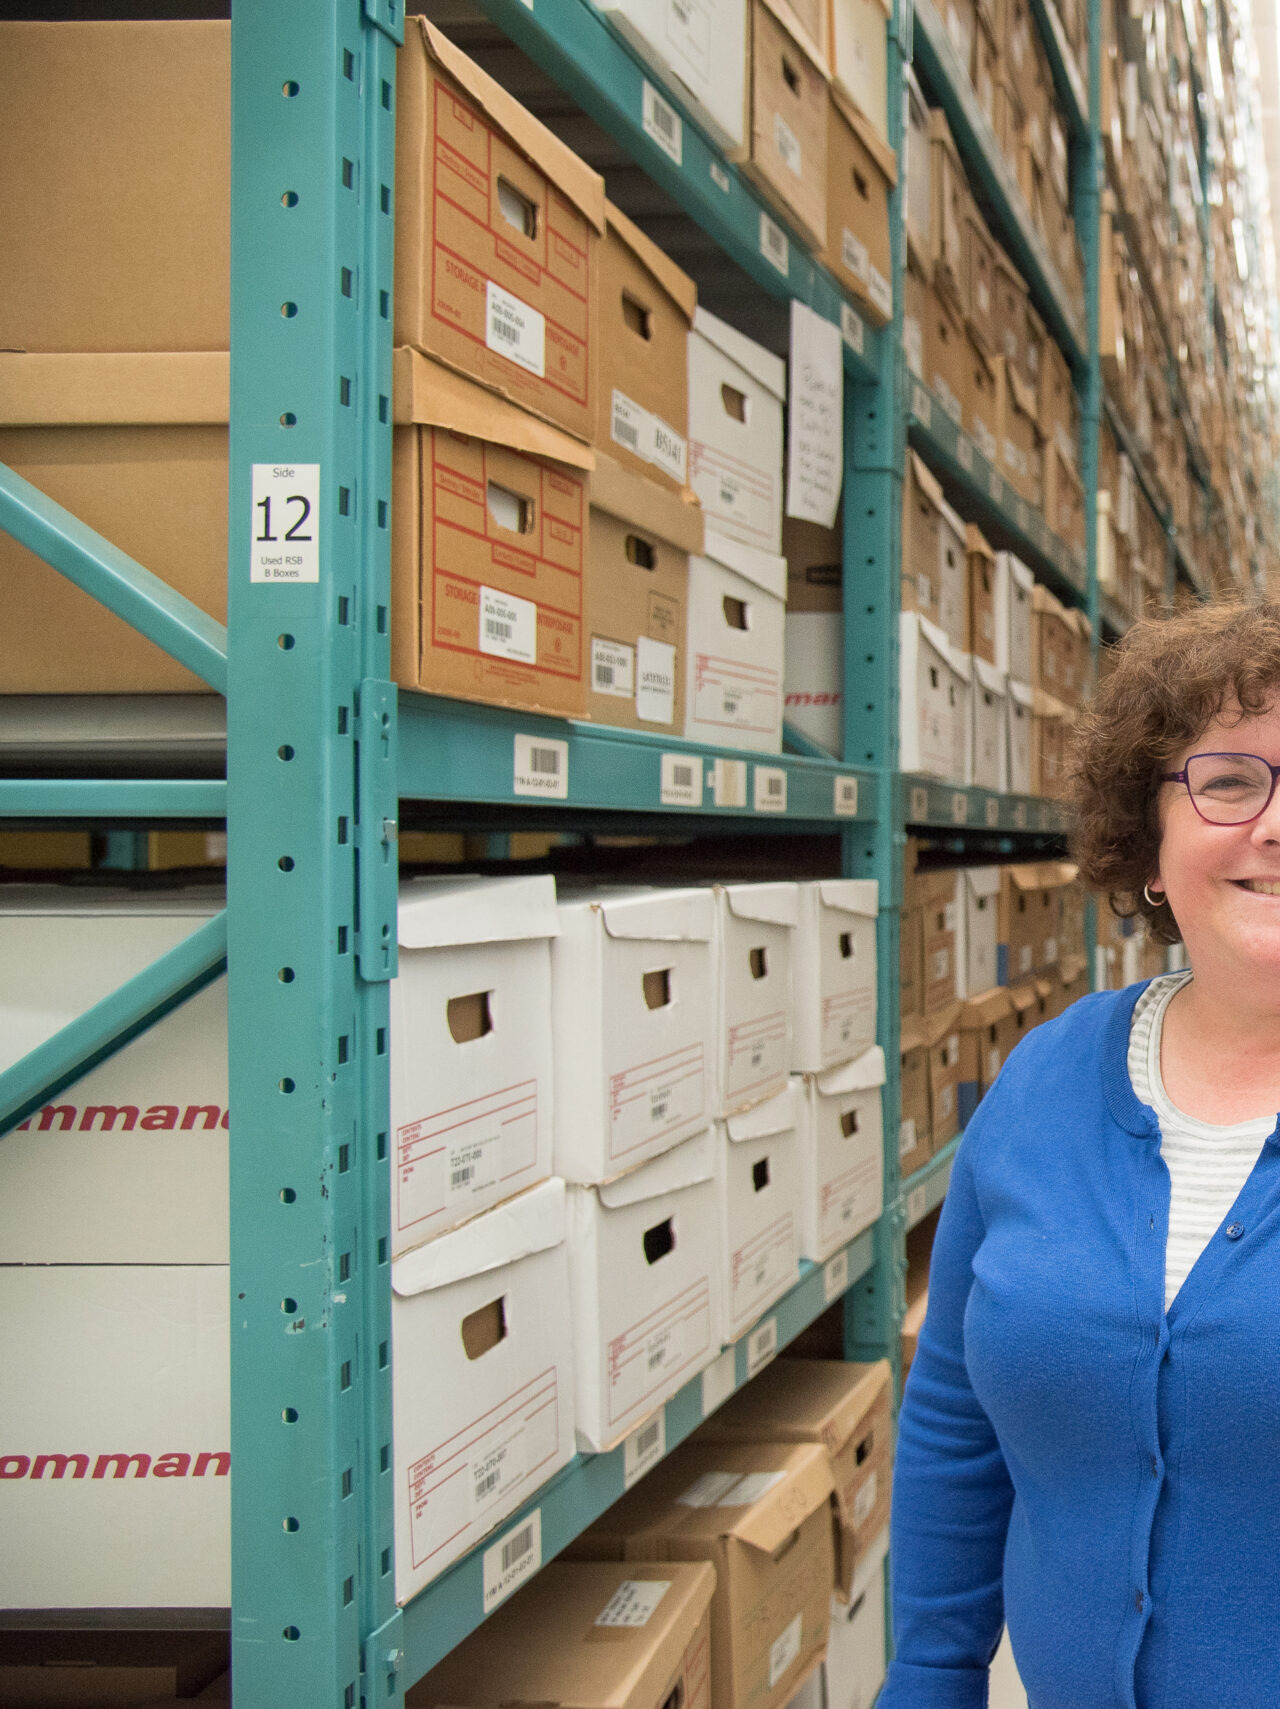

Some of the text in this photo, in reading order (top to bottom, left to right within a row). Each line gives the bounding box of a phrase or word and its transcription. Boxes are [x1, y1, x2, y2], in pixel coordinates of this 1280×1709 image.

[445, 259, 481, 292] STORAGE
[272, 467, 296, 478] Side
[256, 495, 312, 541] 12
[261, 556, 304, 566] Used RSB
[264, 568, 300, 578] B Boxes
[445, 584, 479, 605] STORAGE
